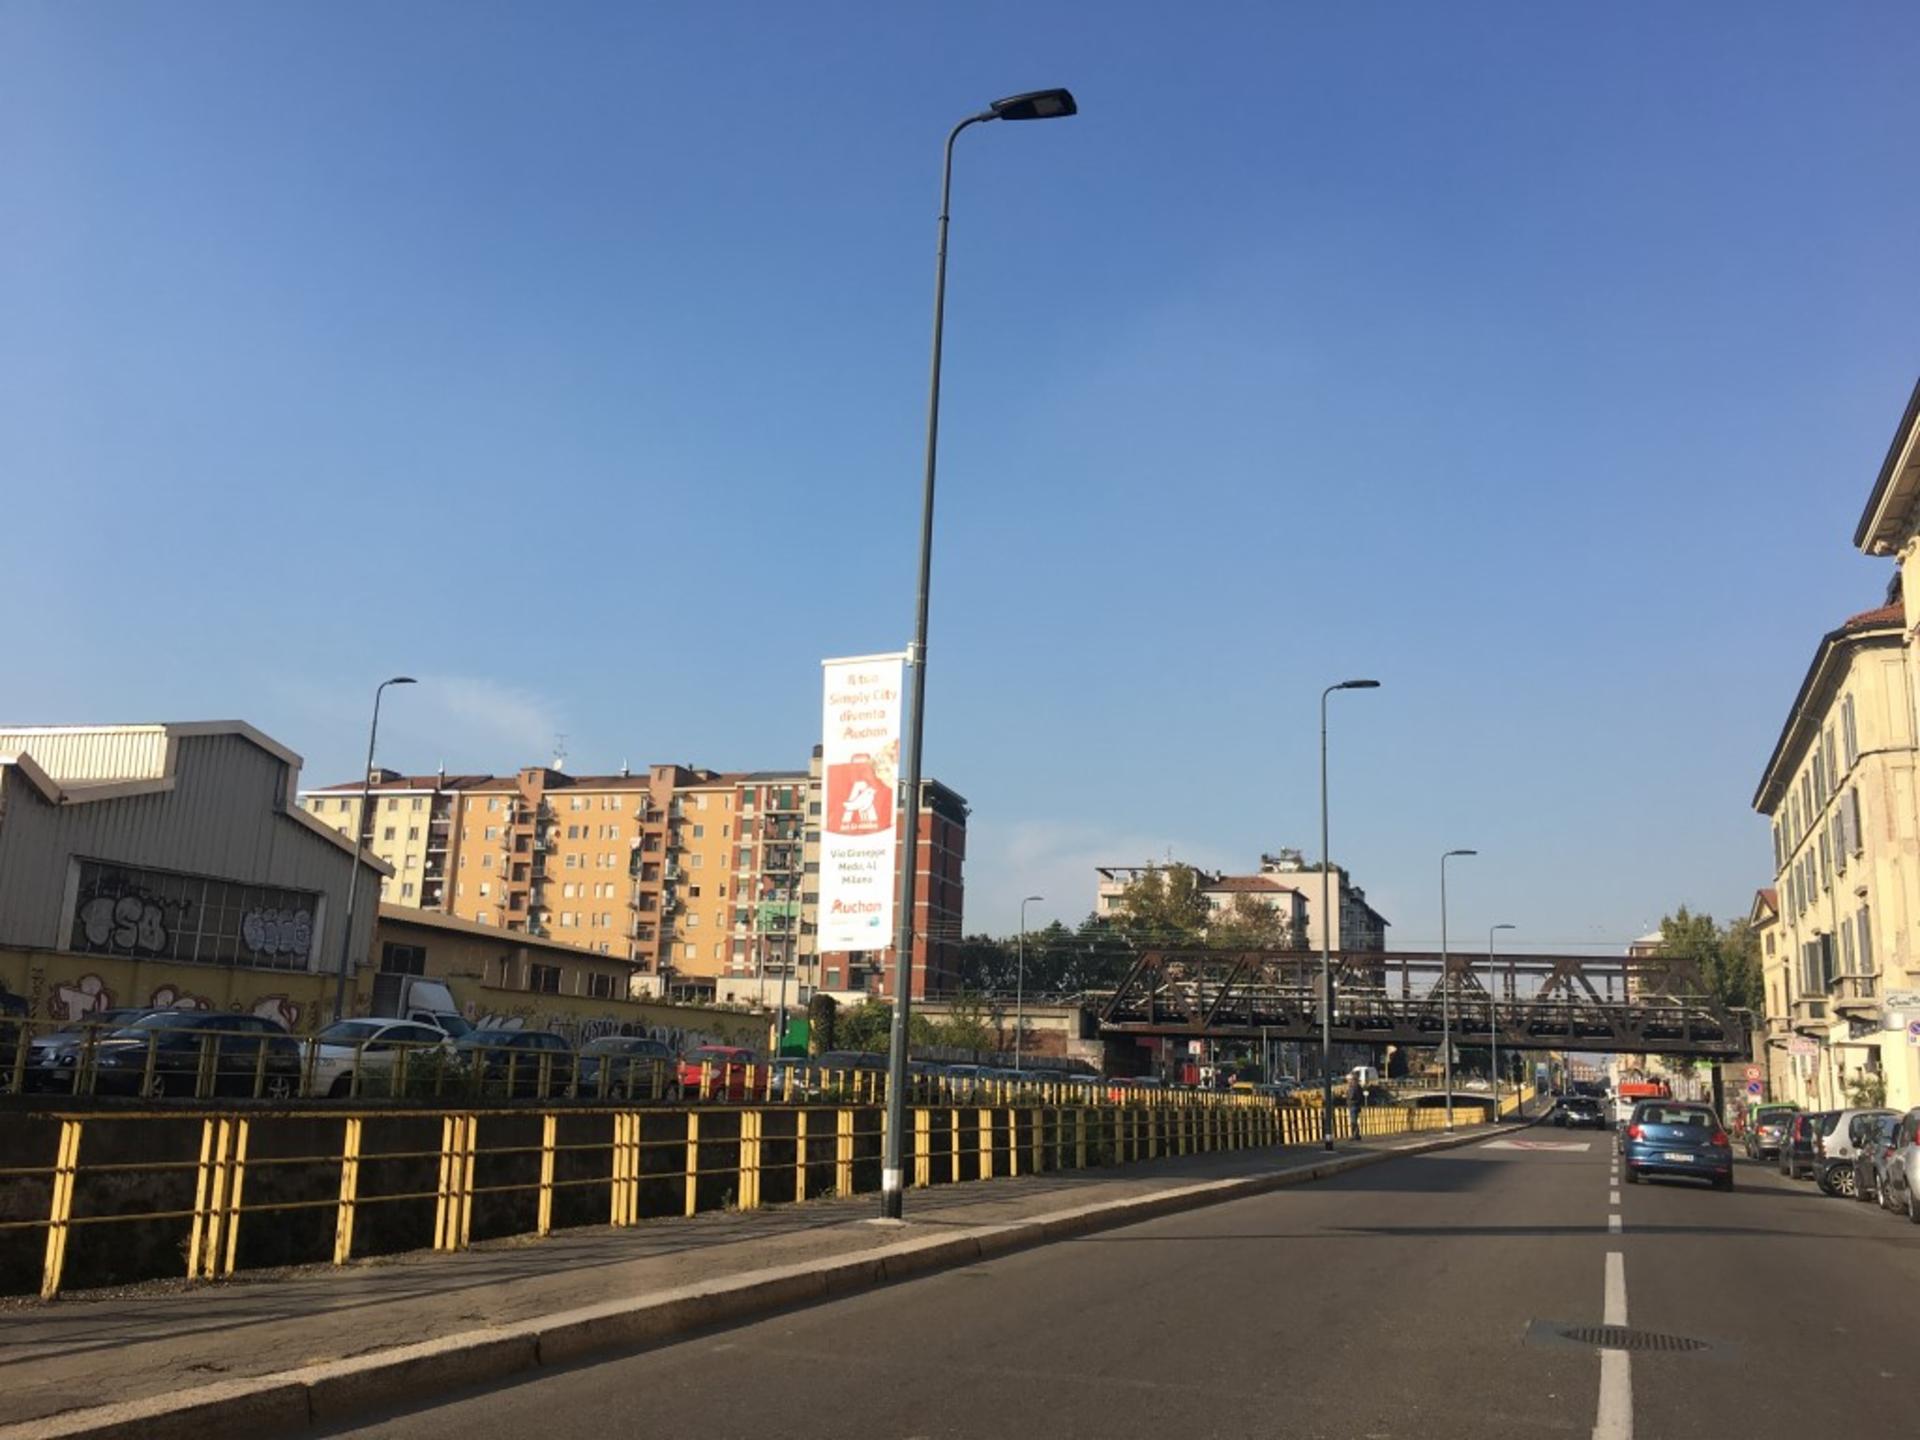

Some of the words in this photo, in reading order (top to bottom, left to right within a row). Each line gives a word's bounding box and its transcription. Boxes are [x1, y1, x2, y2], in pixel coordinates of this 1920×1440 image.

[829, 691, 870, 705] Simply
[873, 688, 897, 702] City
[839, 708, 886, 721] diventa
[843, 726, 888, 739] Auchan
[831, 849, 845, 858] Via
[847, 848, 886, 859] Giuseppe
[841, 875, 873, 885] Milano
[830, 898, 883, 914] Auchan
